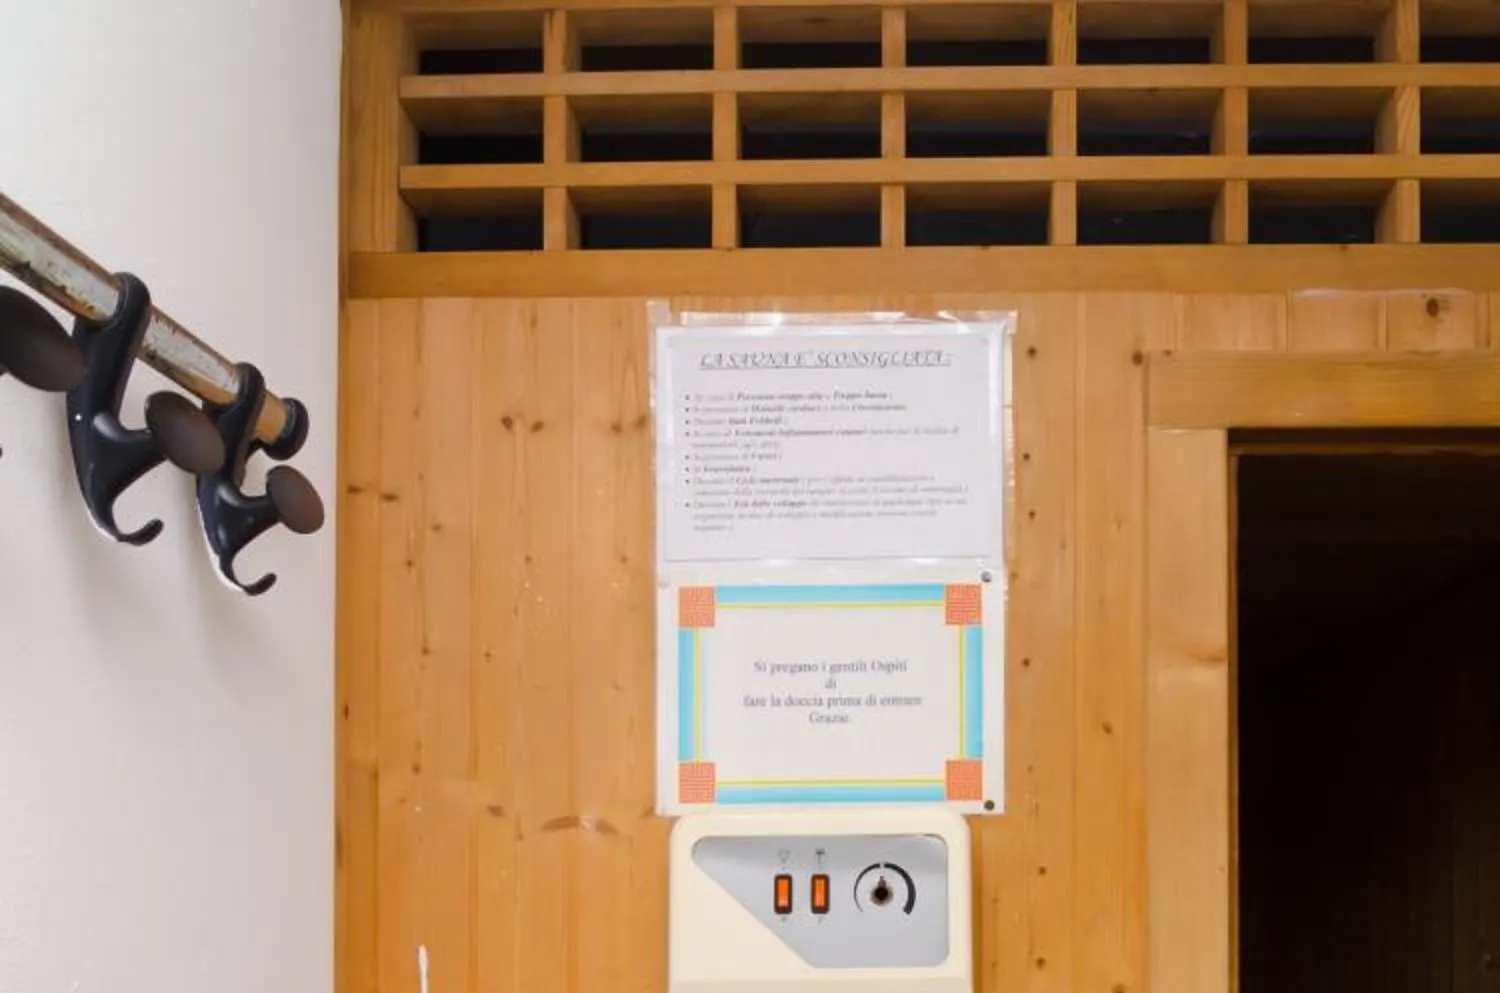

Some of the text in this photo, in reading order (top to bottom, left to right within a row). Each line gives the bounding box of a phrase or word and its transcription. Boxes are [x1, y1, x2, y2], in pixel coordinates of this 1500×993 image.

[725, 351, 791, 368] SAUNA
[754, 659, 767, 673] Si
[770, 661, 819, 678] pregano
[829, 659, 867, 678] gentili
[870, 659, 908, 676] Ospiti
[824, 678, 837, 690] di
[743, 695, 767, 708] fare
[770, 694, 782, 707] la
[784, 694, 824, 707] doccia
[827, 694, 862, 710] prima
[865, 693, 877, 706] di
